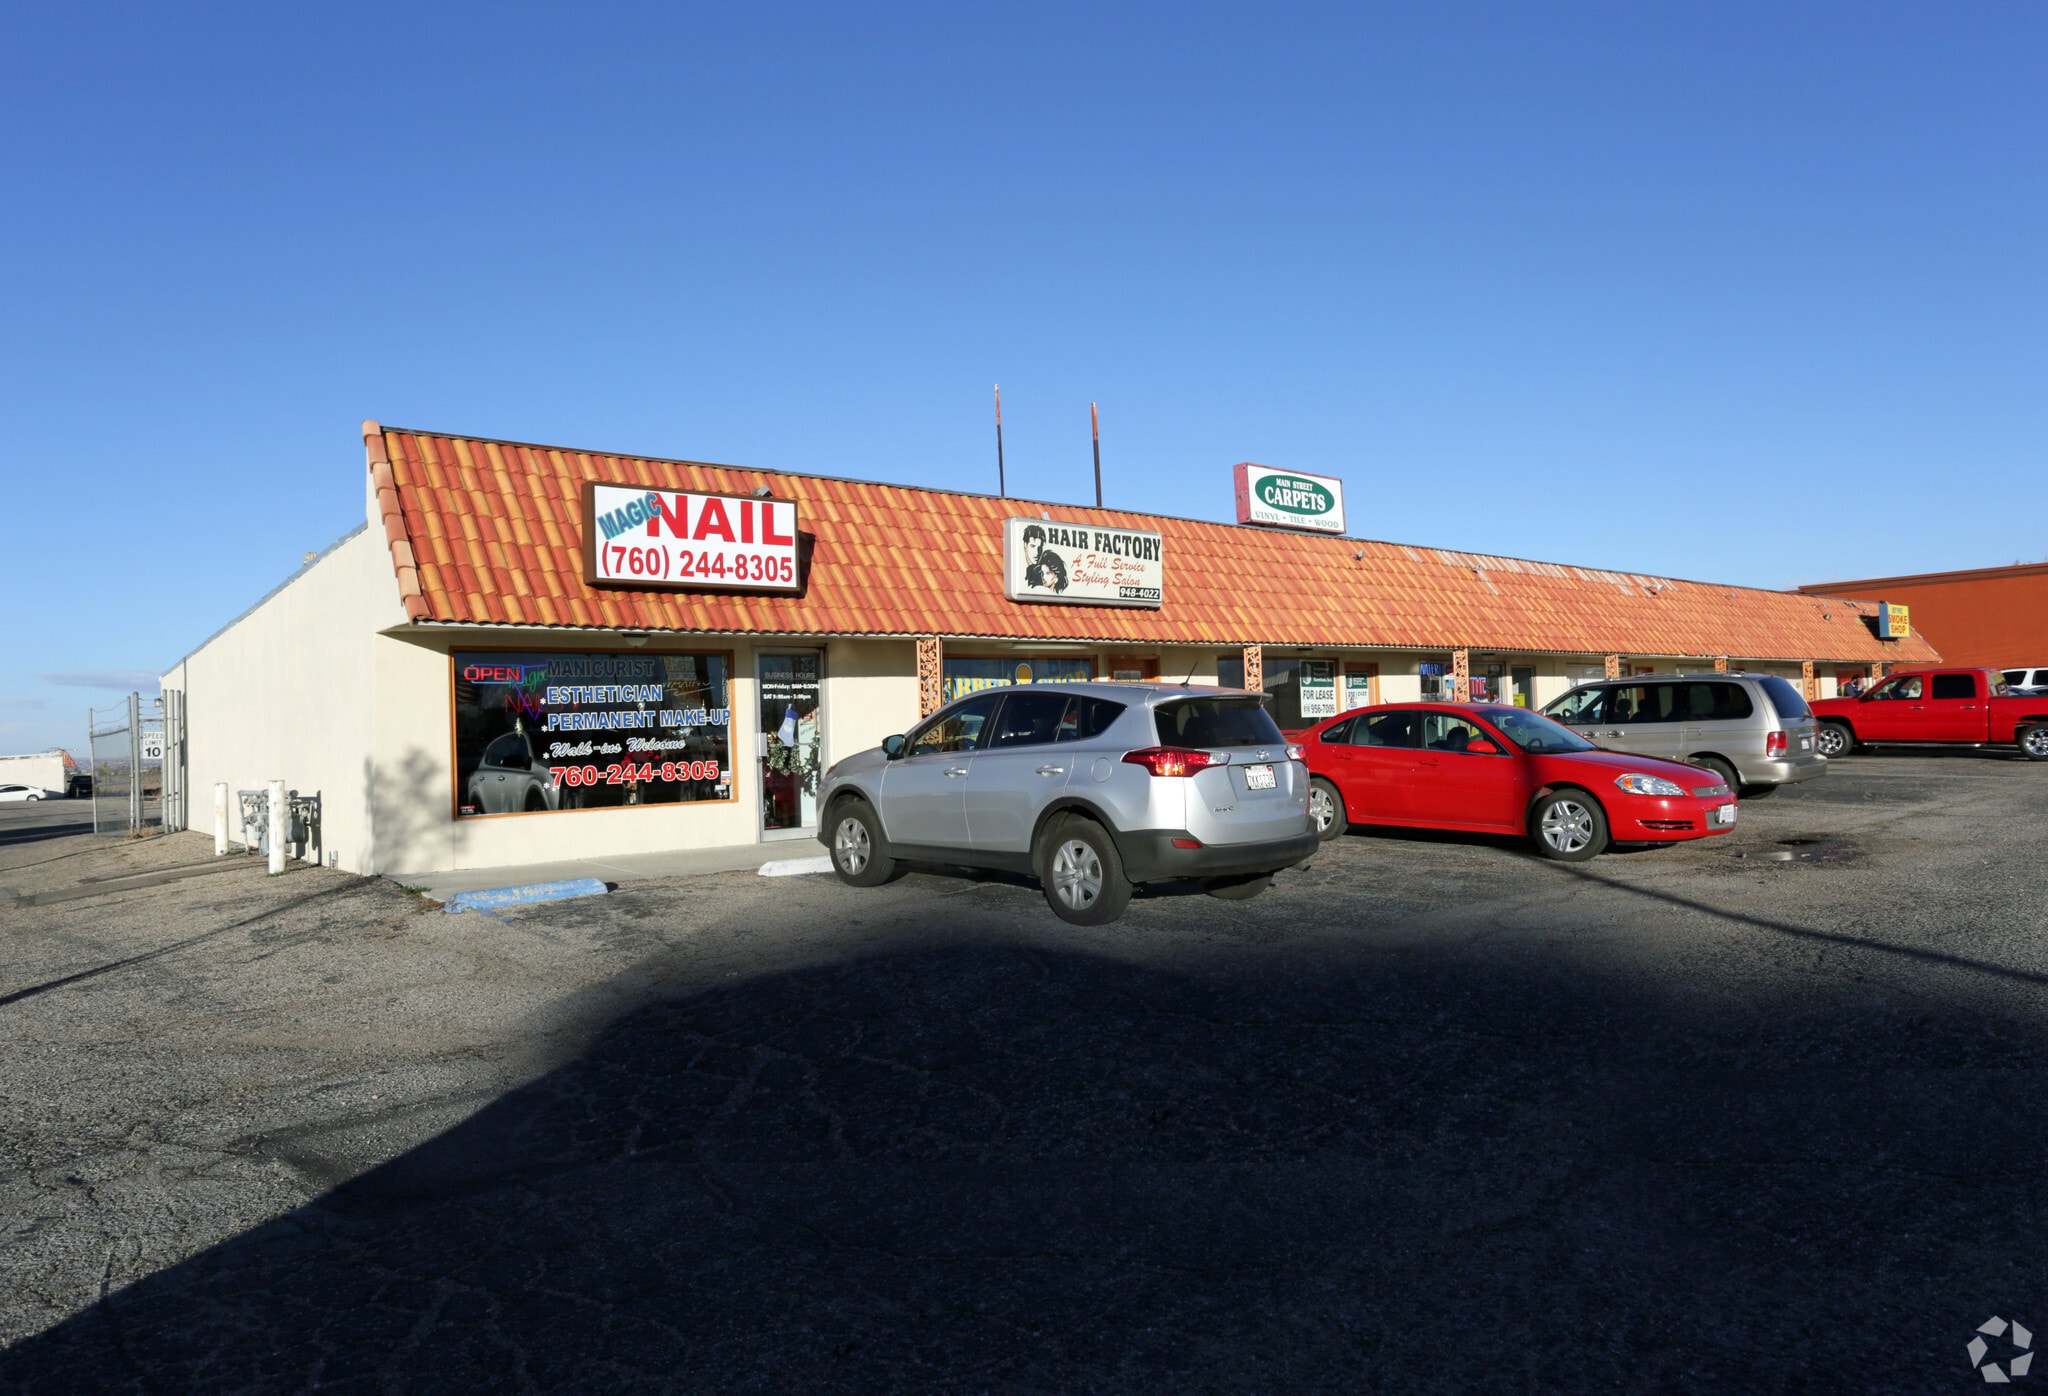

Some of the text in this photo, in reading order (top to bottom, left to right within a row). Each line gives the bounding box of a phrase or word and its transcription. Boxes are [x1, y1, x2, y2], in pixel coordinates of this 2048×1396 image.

[1276, 478, 1314, 492] MAIN STREET
[1264, 486, 1326, 512] CARPETS
[597, 492, 794, 546] MAGIC NAIL
[1255, 510, 1339, 528] VINYL TILE WOOD
[1047, 527, 1161, 562] HAIR FACTORY
[602, 541, 794, 582] (760) 244-8305
[1071, 554, 1146, 572] A Full Service
[1072, 569, 1142, 587] Styling Salon
[1120, 587, 1160, 599] 948-4022
[1888, 614, 1908, 625] SMOKE
[1890, 624, 1906, 634] SHOP
[464, 667, 521, 681] OPEN
[546, 659, 654, 678] MANICURIST
[764, 671, 794, 679] BUSINESS
[547, 685, 663, 705] ESTHETICIAN
[1303, 689, 1334, 700] FOR LEASE
[547, 708, 731, 731] PERMANENT MAKE-UP
[145, 747, 161, 757] 10
[550, 737, 686, 758] Walk-ins Welcome
[550, 761, 719, 787] 760-244-8305
